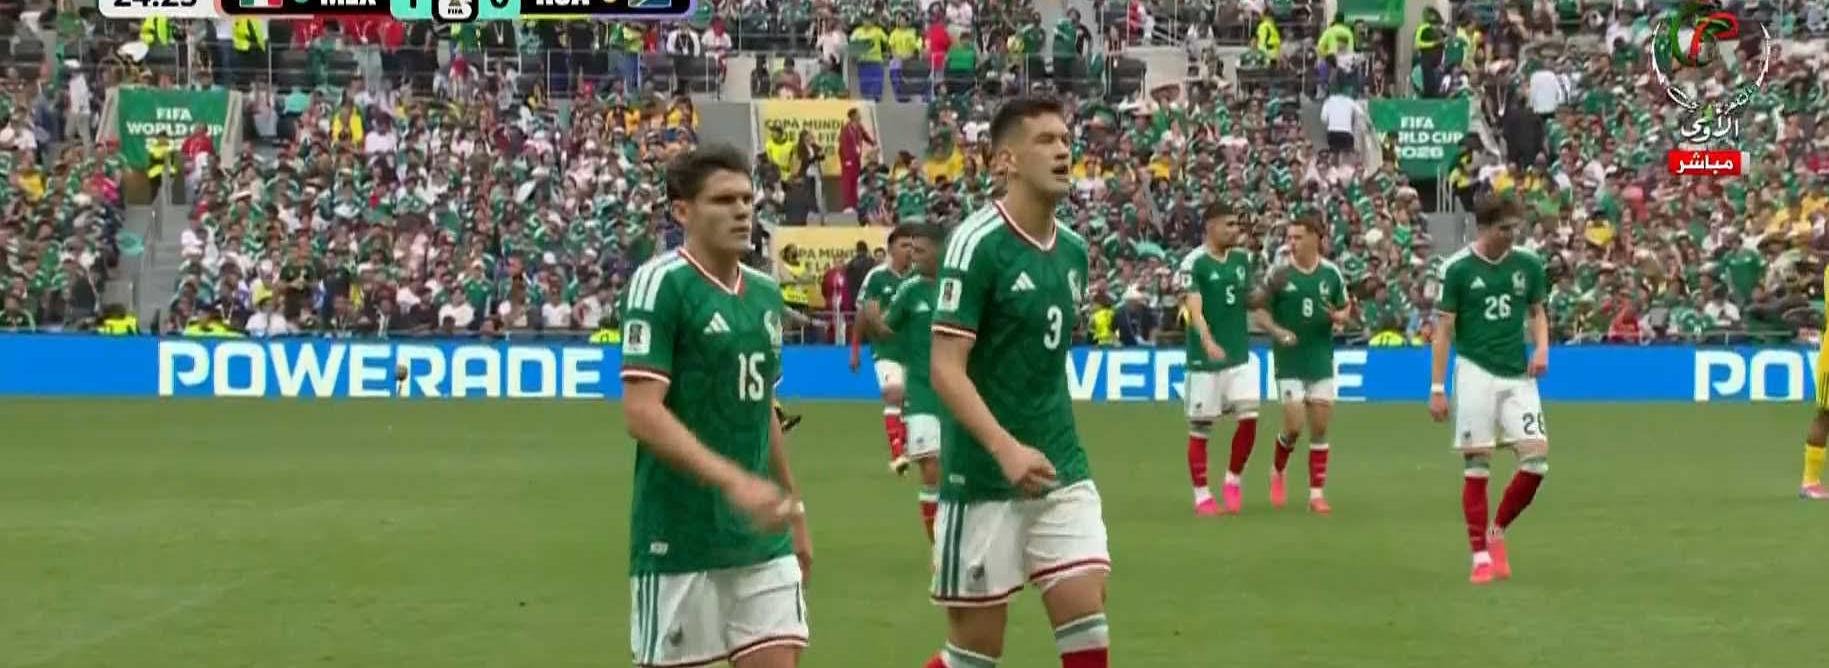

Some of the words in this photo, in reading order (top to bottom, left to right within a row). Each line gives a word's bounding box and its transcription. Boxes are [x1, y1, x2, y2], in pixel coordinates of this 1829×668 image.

[156, 107, 192, 120] FIFA
[802, 118, 844, 129] MUND
[1400, 116, 1434, 129] FIFA
[126, 121, 186, 136] WORLD
[1376, 131, 1430, 143] WRLD
[1431, 131, 1464, 143] CUP
[1225, 285, 1236, 305] 5
[1302, 297, 1314, 318] 8
[1484, 293, 1512, 321] 26
[1043, 305, 1063, 350] 3
[158, 341, 605, 398] POWERADE
[738, 352, 766, 401] 15
[1693, 349, 1822, 402] PO
